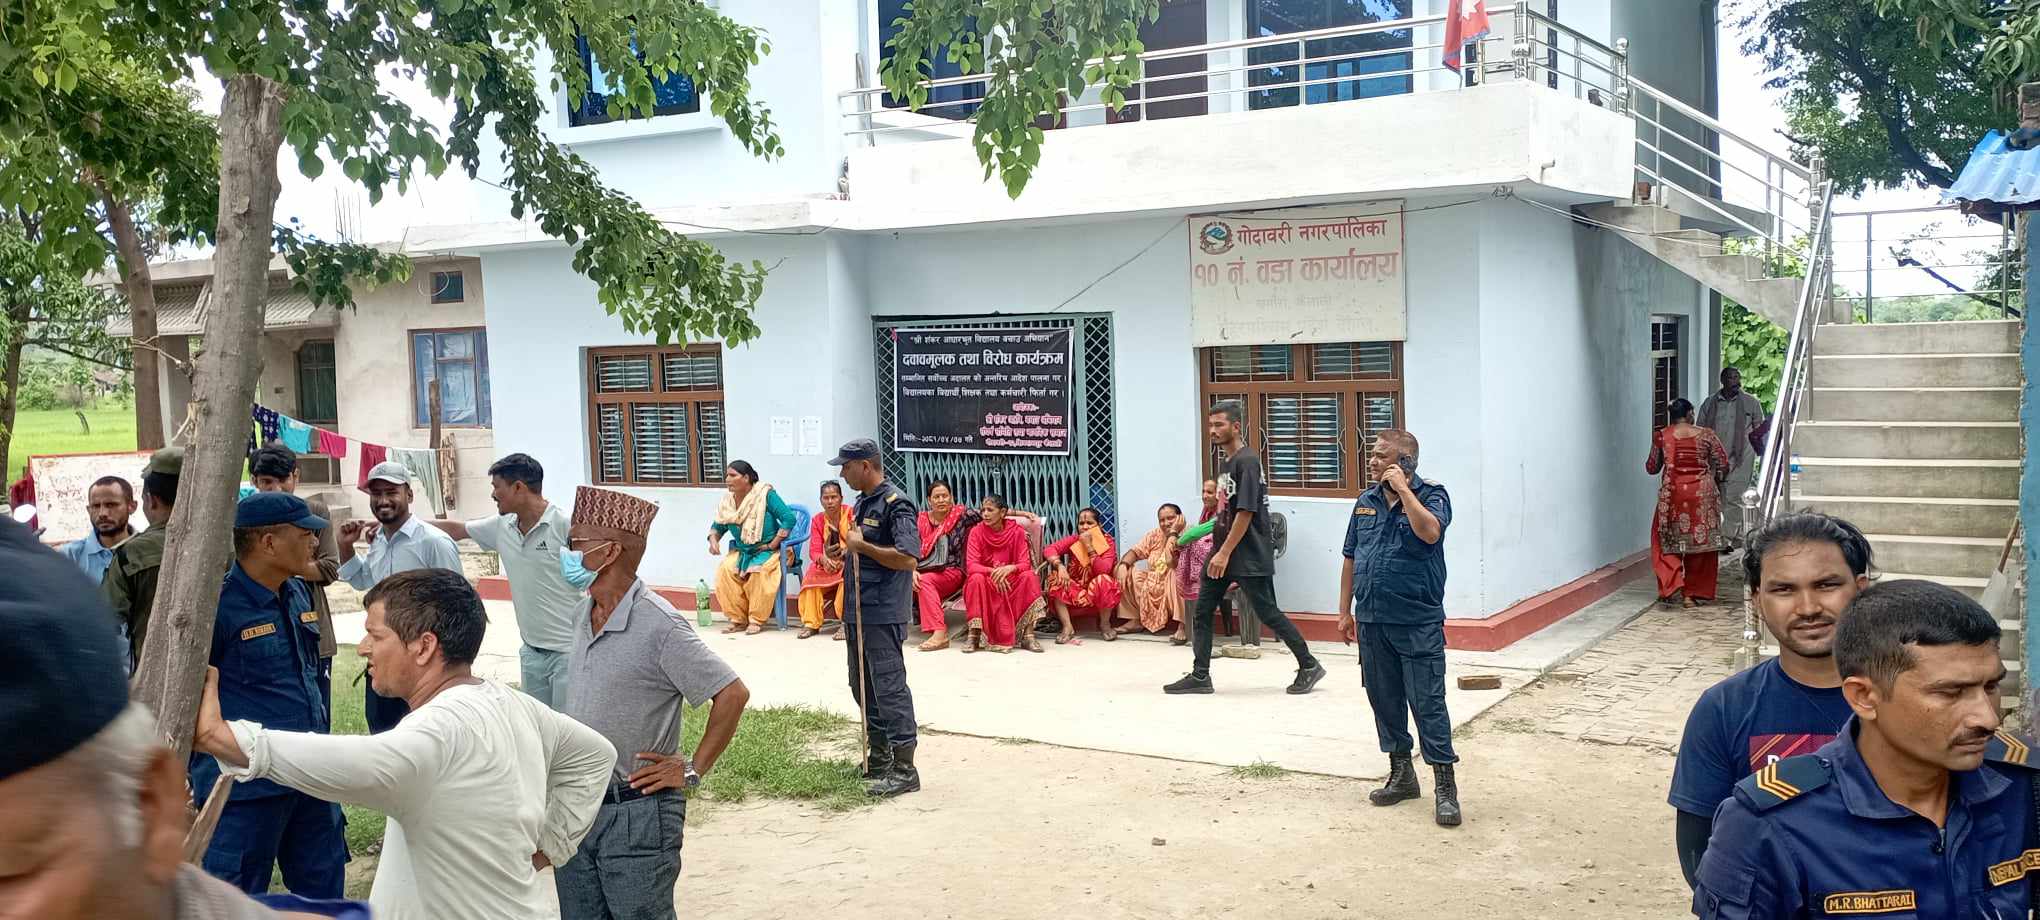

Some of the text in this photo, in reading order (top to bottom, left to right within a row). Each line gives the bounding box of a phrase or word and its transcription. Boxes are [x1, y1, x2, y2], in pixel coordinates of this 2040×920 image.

[1236, 216, 1388, 246] गोदावरी नगरपालिका
[1194, 263, 1219, 288] १०
[1300, 247, 1399, 281] कार्यालय
[959, 353, 979, 366] तथा
[983, 349, 1012, 366] विरोध
[1015, 349, 1064, 366] कार्यक्रम
[1829, 894, 1911, 910] M.R.BHATTARAI
